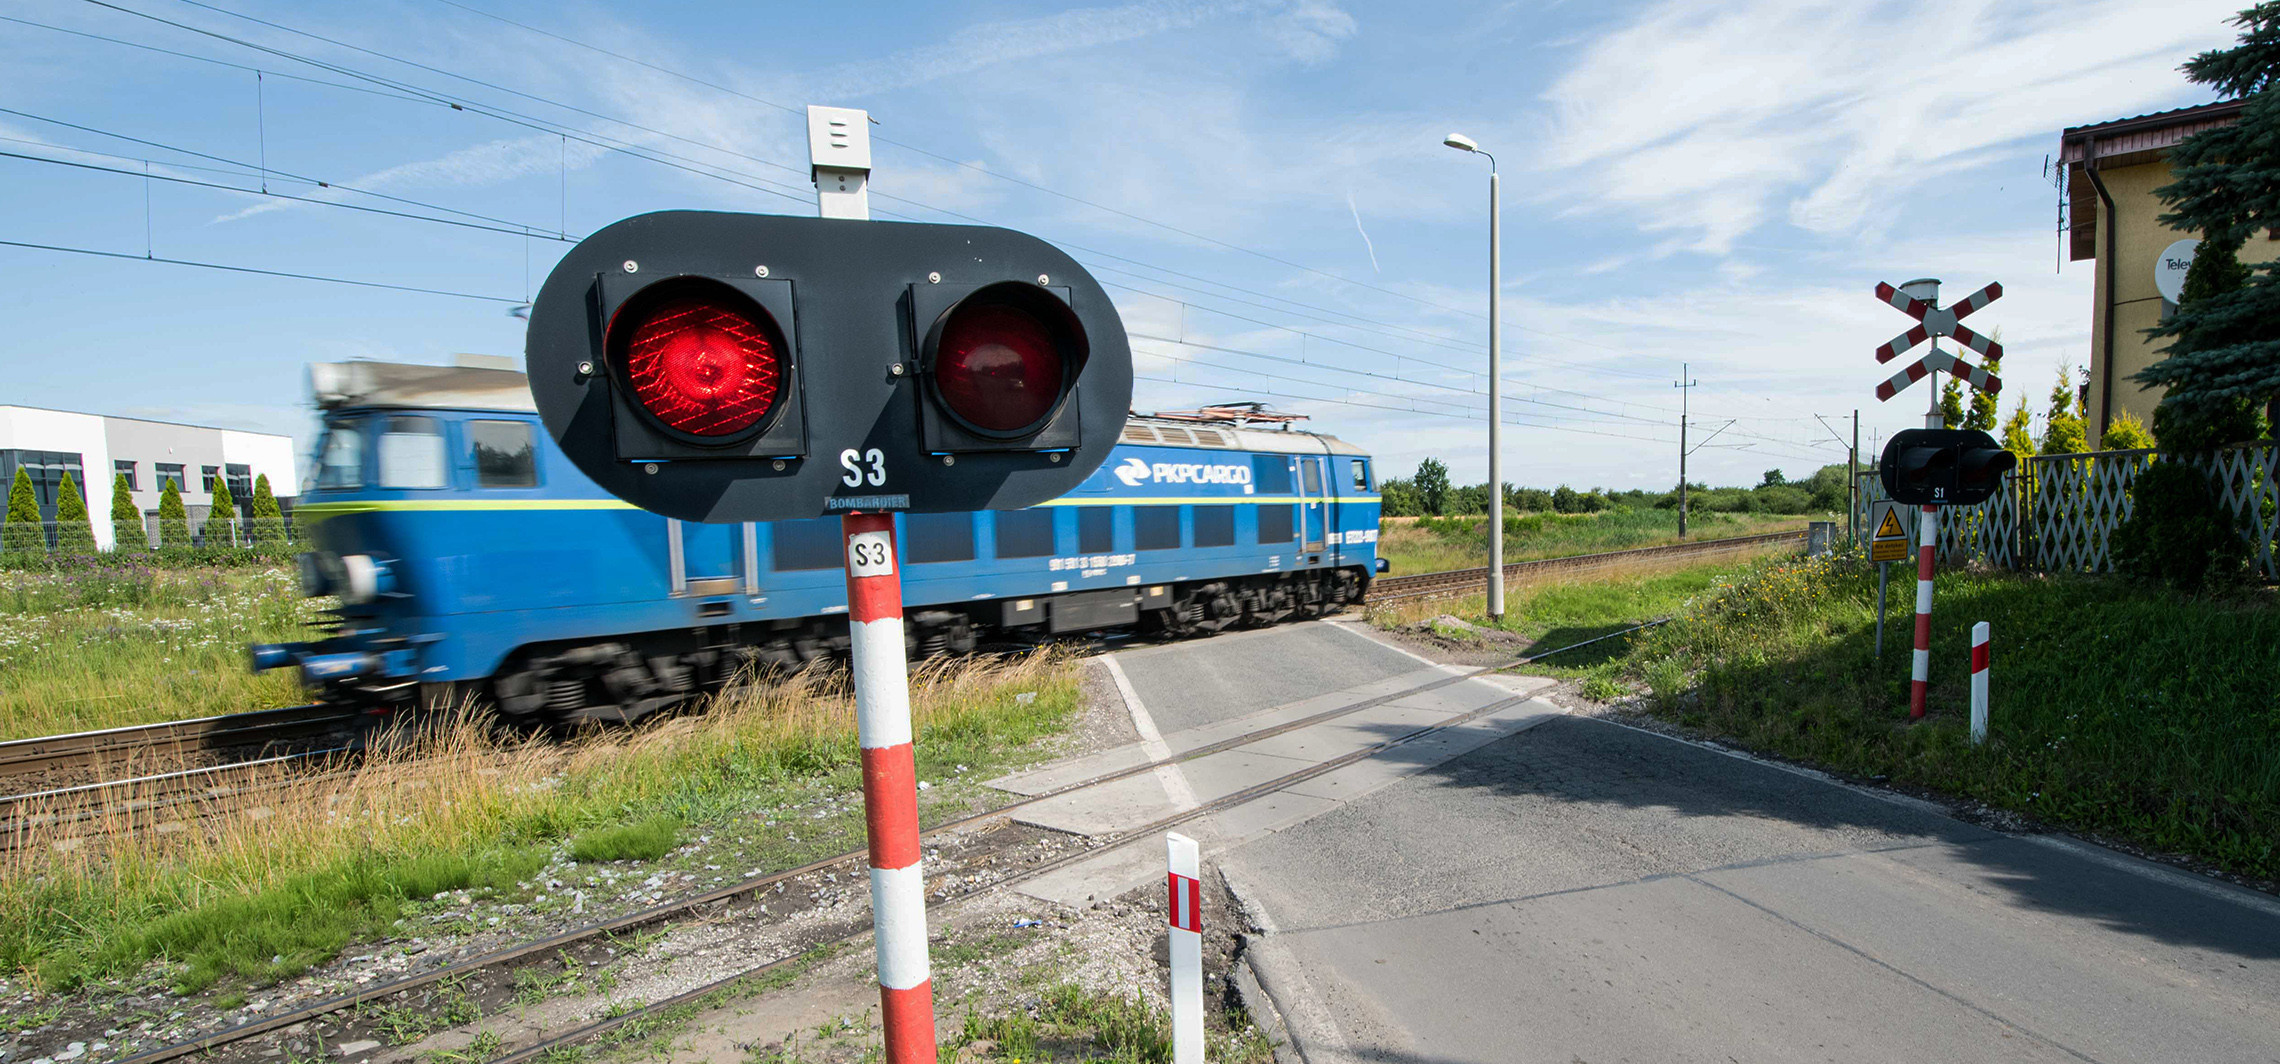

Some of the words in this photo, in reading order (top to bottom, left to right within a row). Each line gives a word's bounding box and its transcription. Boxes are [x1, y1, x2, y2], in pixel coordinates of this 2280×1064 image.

[840, 448, 886, 487] S3
[1934, 487, 1944, 498] S1
[829, 496, 906, 509] BOMBARDIER
